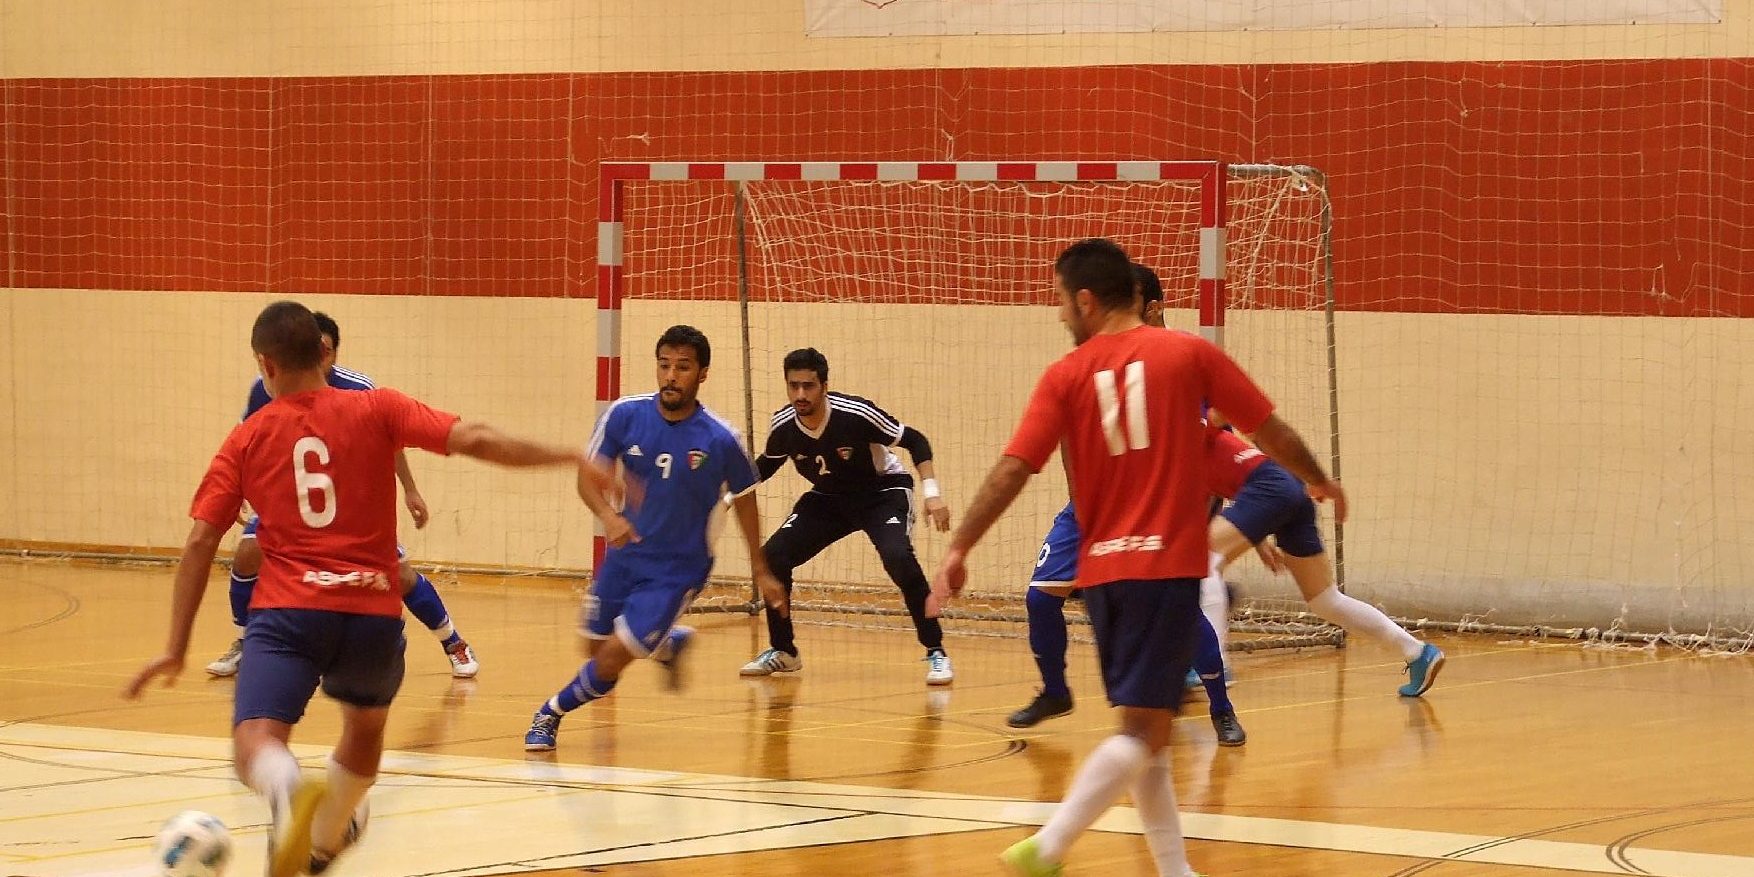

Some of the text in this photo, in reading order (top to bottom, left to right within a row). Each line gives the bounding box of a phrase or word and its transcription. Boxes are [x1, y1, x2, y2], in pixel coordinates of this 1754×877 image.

[1093, 360, 1150, 456] 11
[293, 436, 336, 529] 6
[655, 453, 673, 479] 9
[815, 455, 831, 475] 2
